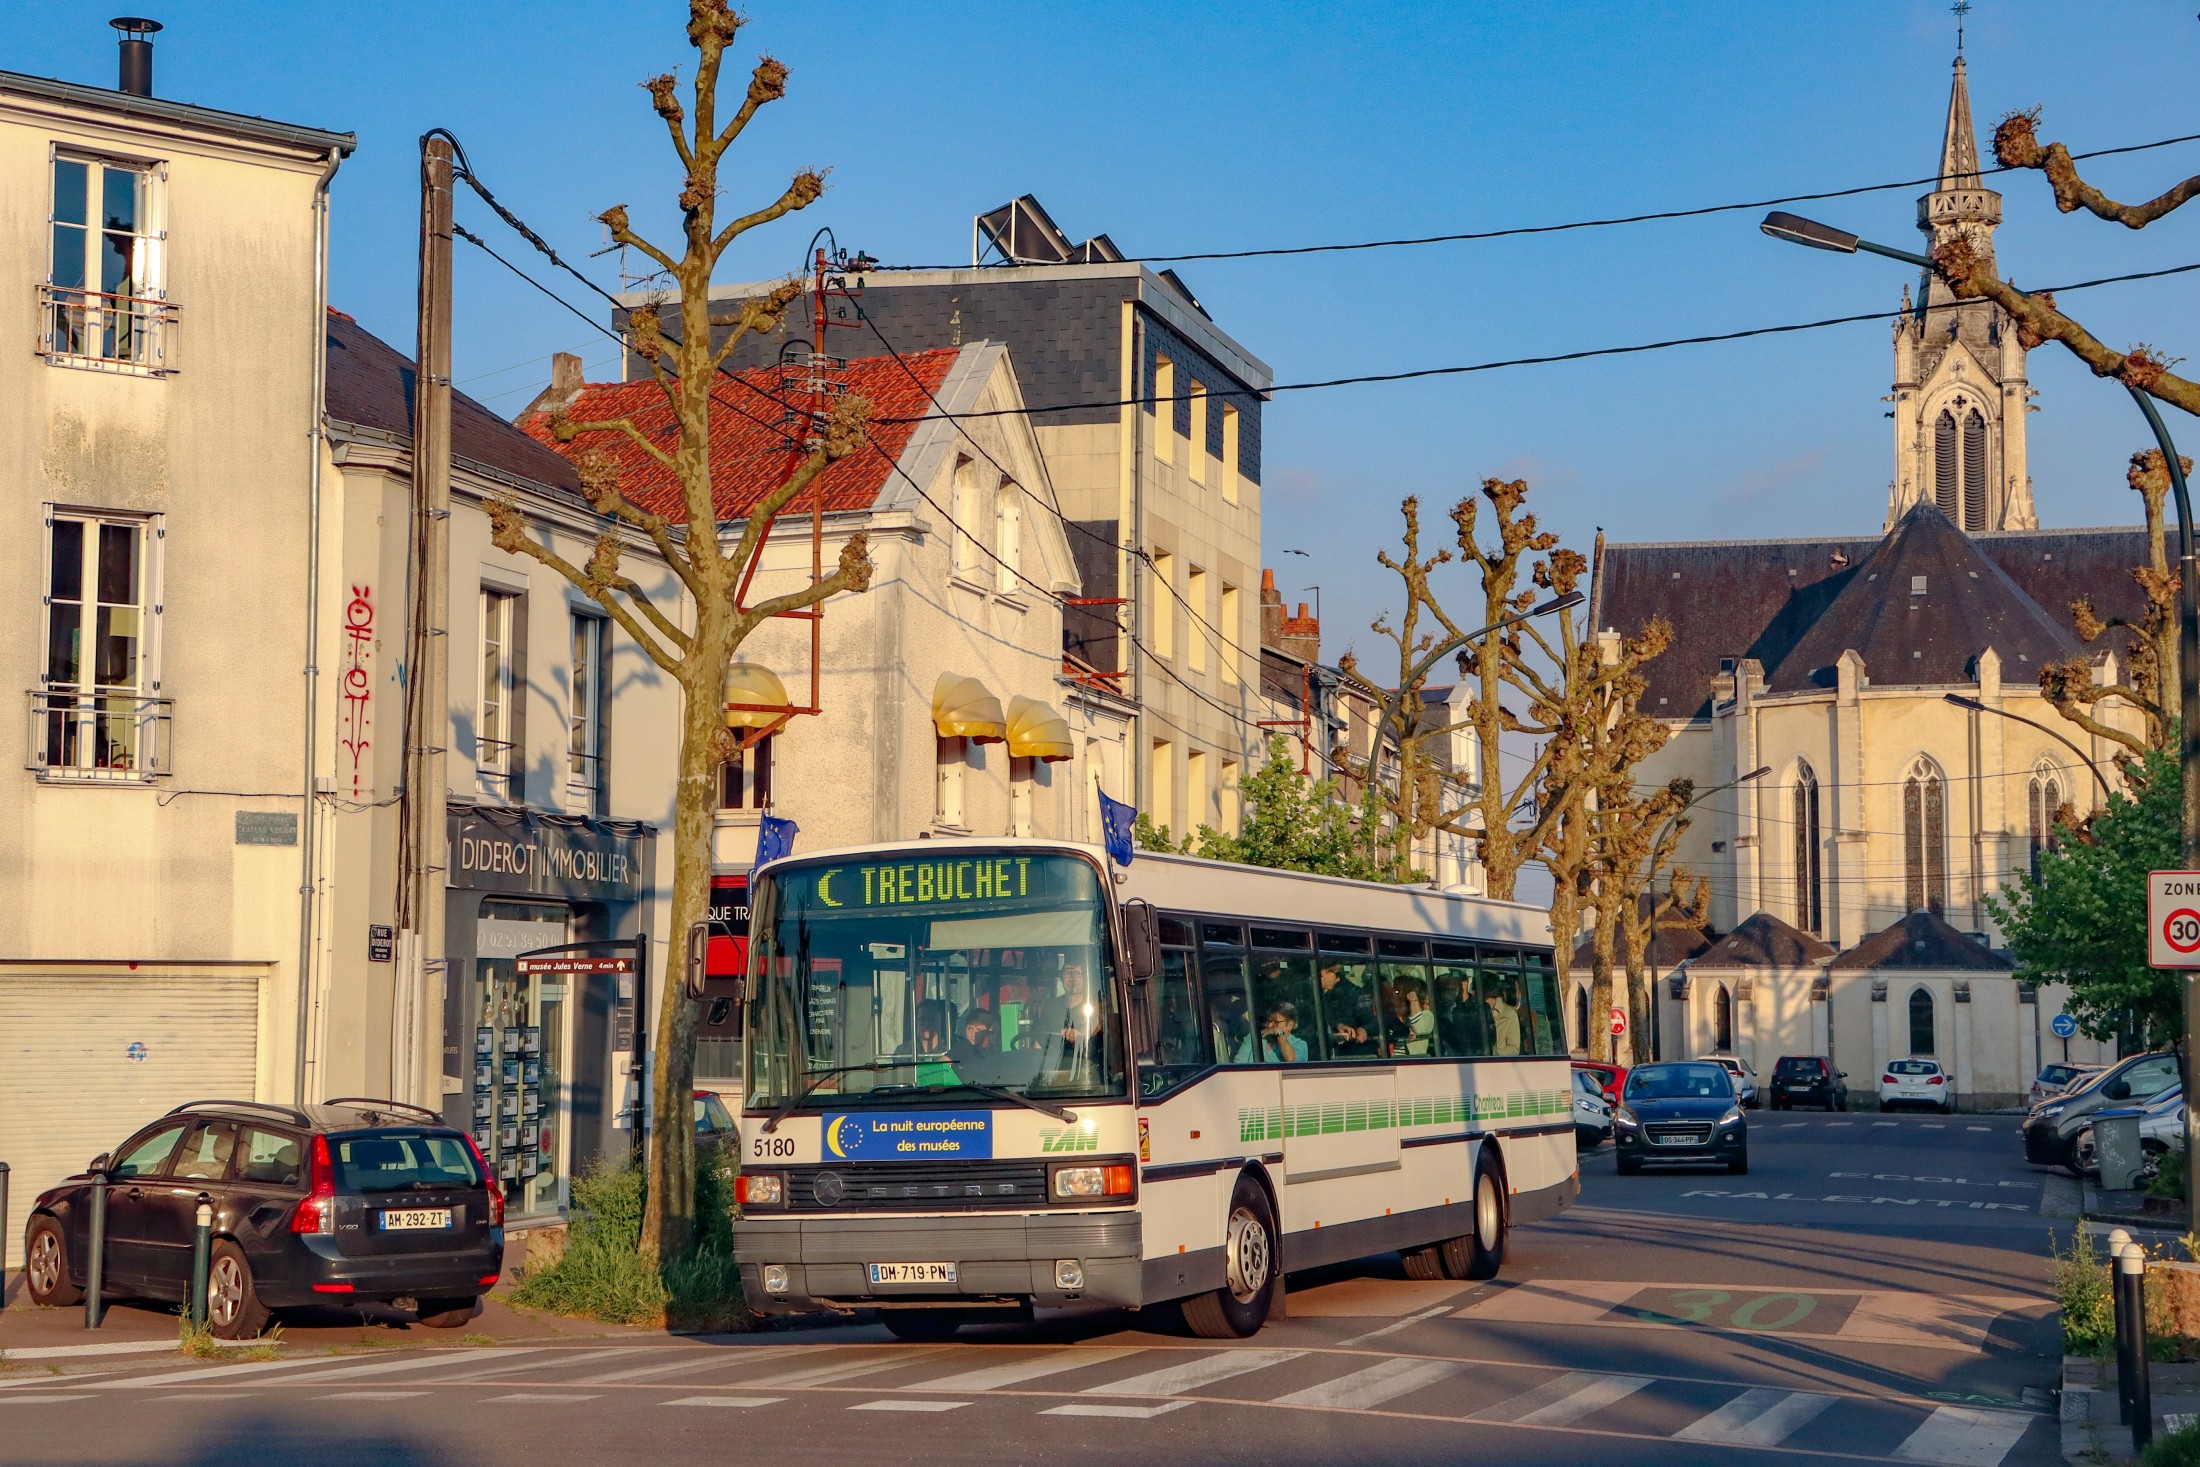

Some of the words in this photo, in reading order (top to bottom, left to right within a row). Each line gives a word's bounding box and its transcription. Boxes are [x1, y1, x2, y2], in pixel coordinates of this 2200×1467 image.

[462, 838, 537, 875] DIDEROT
[542, 847, 629, 884] IMMOBILIER
[860, 858, 1033, 905] TREBUCHET
[734, 906, 750, 920] TR
[2172, 920, 2200, 941] 30
[521, 933, 533, 948] 84
[529, 962, 552, 970] musée
[553, 962, 571, 970] Jules
[573, 962, 593, 970] Verne
[872, 1120, 888, 1132] La
[890, 1120, 914, 1132] nuit
[916, 1119, 985, 1133] européenne
[897, 1140, 916, 1152] des
[919, 1139, 960, 1152] musées
[1039, 1126, 1100, 1152] TAN
[754, 1138, 795, 1157] 5180
[1828, 1171, 2040, 1189] ECOLE
[871, 1184, 1014, 1197] SETRA
[1679, 1190, 2032, 1212] RALENTIR
[388, 1212, 443, 1227] AM-292-ZT
[880, 1265, 947, 1280] DM-719-PN
[1637, 1289, 1818, 1330] 30
